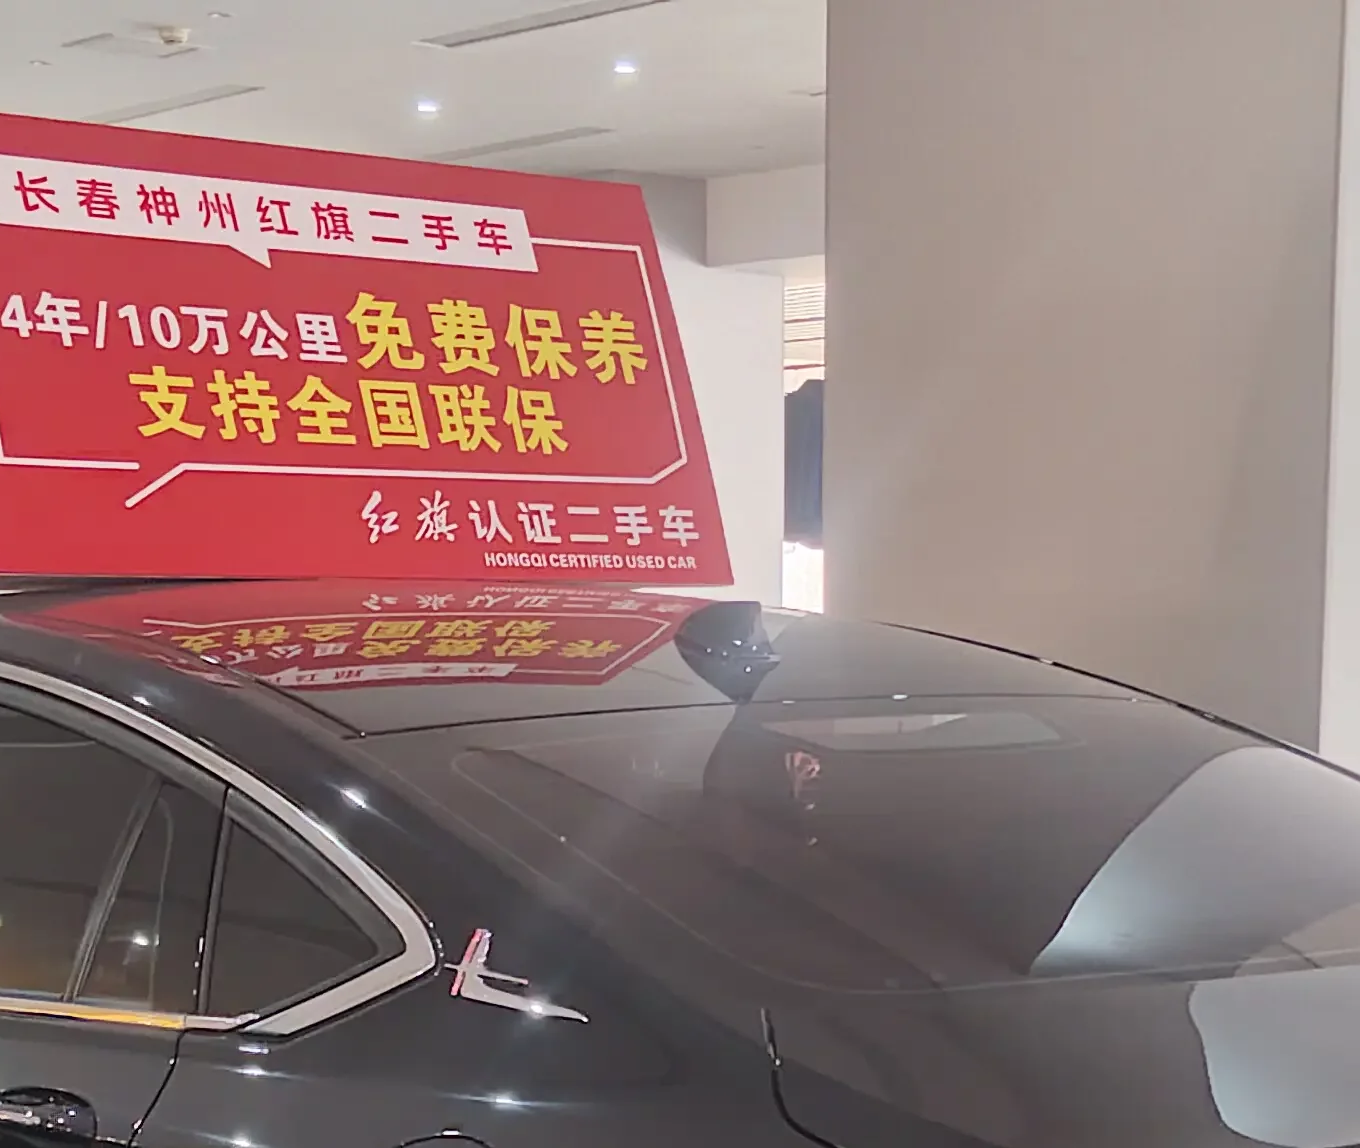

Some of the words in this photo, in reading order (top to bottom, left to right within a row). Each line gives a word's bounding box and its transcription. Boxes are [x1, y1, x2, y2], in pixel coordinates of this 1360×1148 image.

[14, 171, 513, 256] 长春神州红旗二手车
[0, 291, 648, 386] 4年/10万公里免费保养
[129, 365, 568, 454] 支持全国联保
[361, 490, 699, 547] 红旗认证二手车
[485, 552, 547, 568] HONGQI
[549, 553, 623, 569] CERTIFIED
[626, 555, 665, 569] USED
[667, 556, 696, 570] CAR
